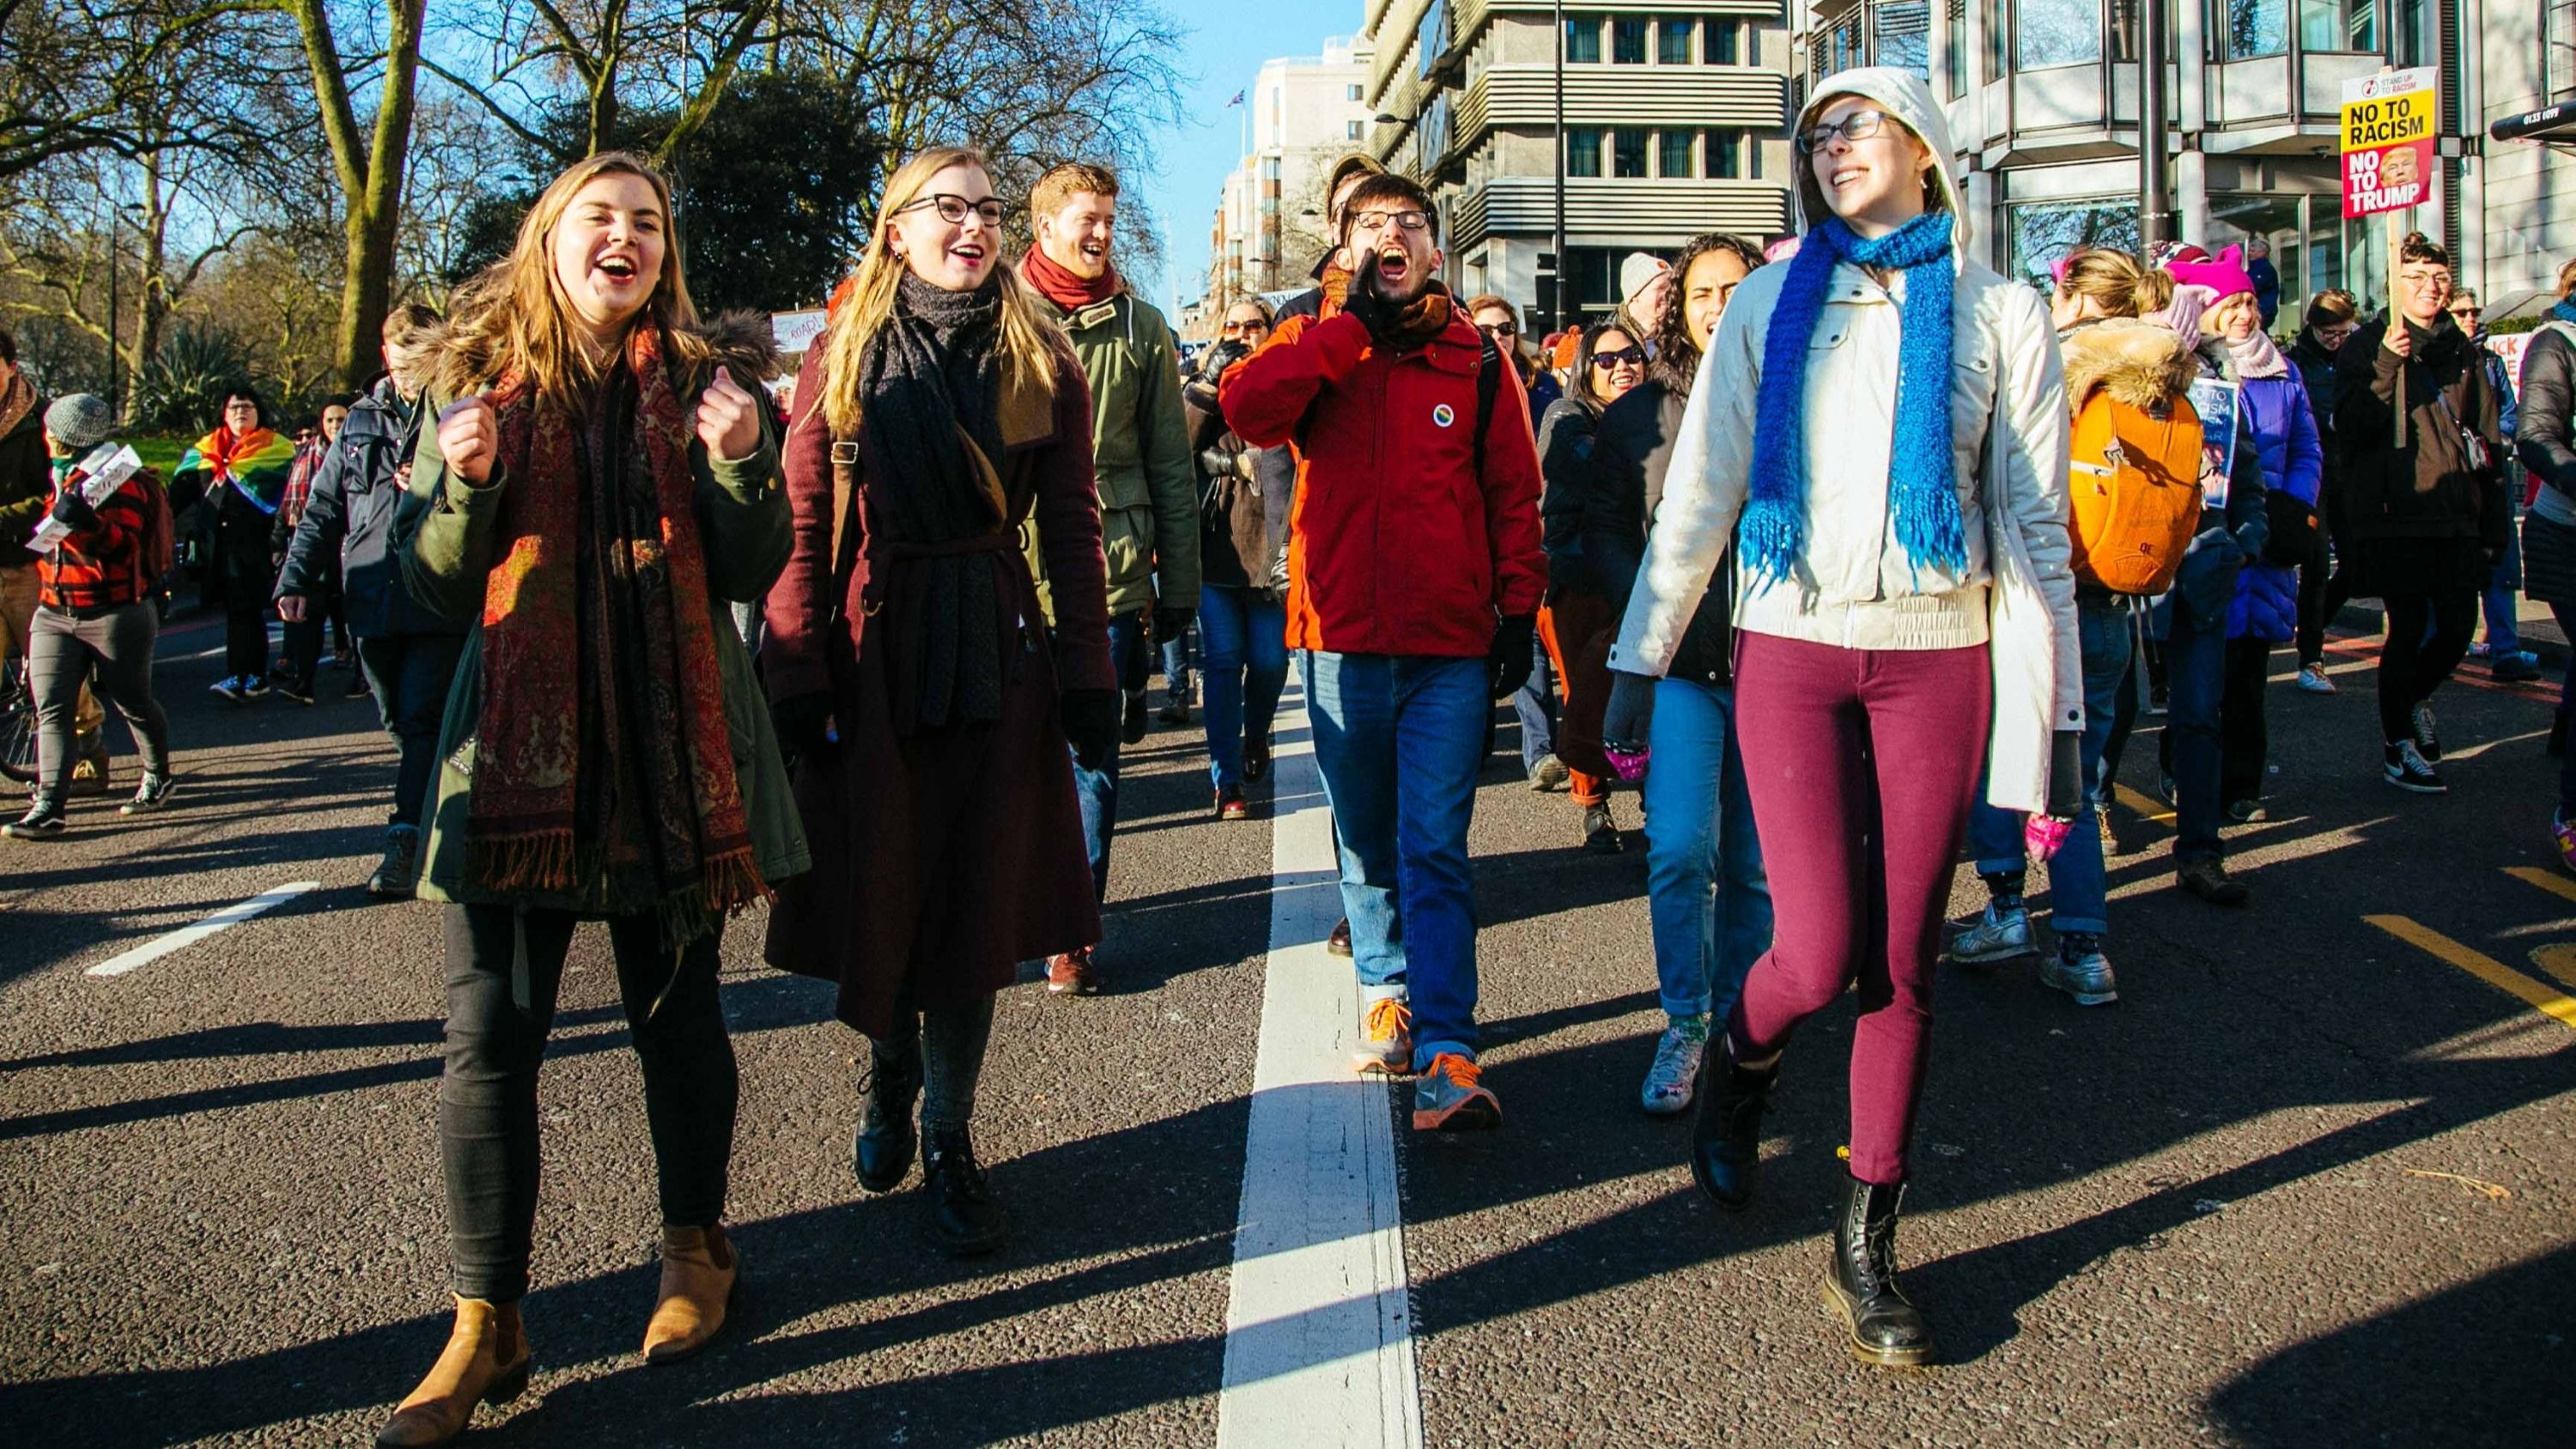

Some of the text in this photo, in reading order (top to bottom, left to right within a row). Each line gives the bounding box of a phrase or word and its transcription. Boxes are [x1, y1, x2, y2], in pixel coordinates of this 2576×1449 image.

[2381, 76, 2403, 86] STAND
[2392, 82, 2416, 93] RACISM
[2351, 99, 2409, 125] NO TO
[2351, 115, 2423, 145] RACISM
[2349, 150, 2379, 174] NO
[2349, 171, 2377, 192] TO
[2349, 183, 2420, 213] TRUMP
[2211, 391, 2226, 401] TO
